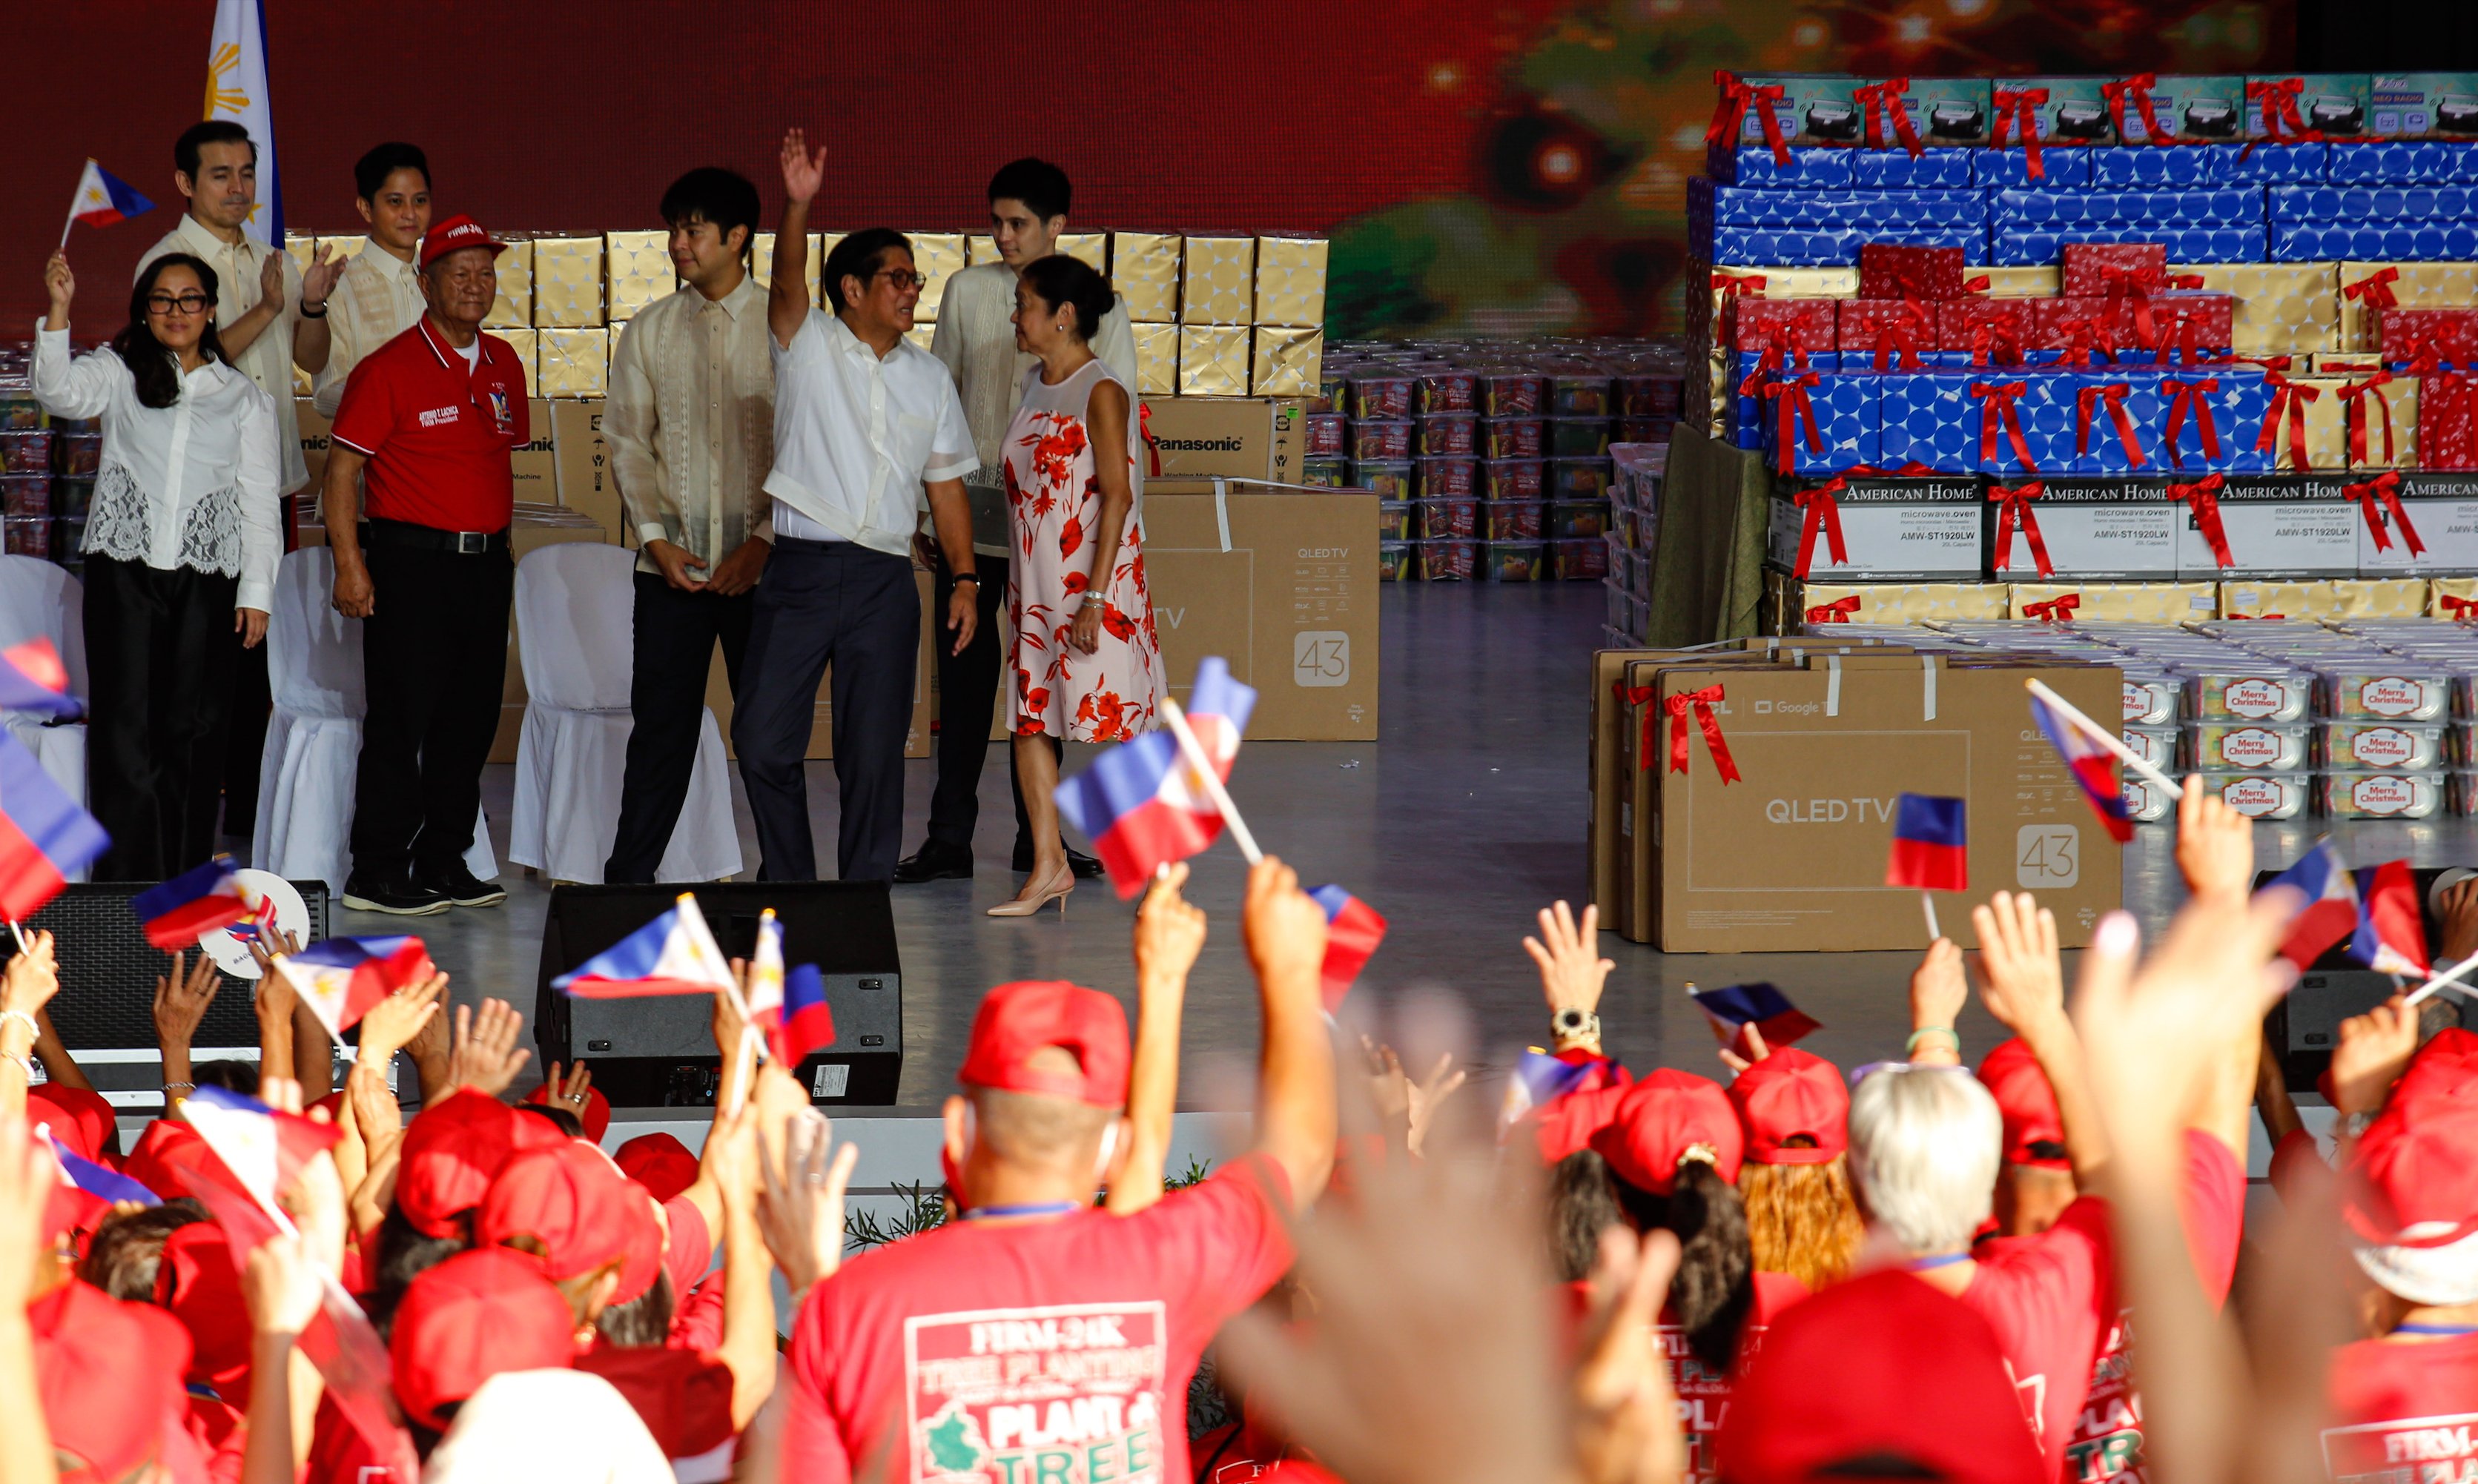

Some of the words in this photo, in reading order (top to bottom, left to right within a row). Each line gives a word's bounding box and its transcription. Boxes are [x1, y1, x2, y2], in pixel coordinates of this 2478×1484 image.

[1148, 437, 1242, 451] Panasonic
[1845, 485, 1923, 500] AMERICAN
[1928, 483, 1974, 500] HOME
[2039, 485, 2119, 500] AMERICAN
[2220, 483, 2300, 499] AMERICAN
[2304, 482, 2342, 498] HOM
[1901, 509, 1975, 518] microwave.oven
[2094, 508, 2170, 517] microwave.oven
[2275, 506, 2351, 514] microwave.oven
[1900, 531, 1975, 540] AMW-ST1920LW
[2094, 530, 2169, 539] AMW-ST1920LW
[2275, 528, 2350, 537] AMW-ST1920LW
[1298, 549, 1330, 558] QLED
[1332, 548, 1348, 558] TV
[1298, 640, 1346, 678] 43
[2241, 690, 2267, 700] Merry
[2378, 688, 2405, 698] Merry
[2231, 698, 2276, 706] Christmas
[2368, 695, 2414, 704] Christmas
[1777, 701, 1819, 715] Google
[2020, 729, 2047, 741] QLE
[2238, 739, 2264, 749] Merry
[2370, 738, 2397, 748] Merry
[2228, 746, 2273, 755] Christmas
[2360, 746, 2405, 755] Christmas
[2239, 789, 2266, 798] Merry
[2370, 786, 2397, 796] Merry
[2230, 796, 2275, 805] Christmas
[2360, 794, 2406, 803] Christmas
[1766, 798, 1849, 824] QLED
[1852, 798, 1895, 823] TV
[2021, 835, 2073, 877] 43
[988, 1395, 1125, 1448] PLANT
[2384, 1425, 2478, 1463] FIRM-
